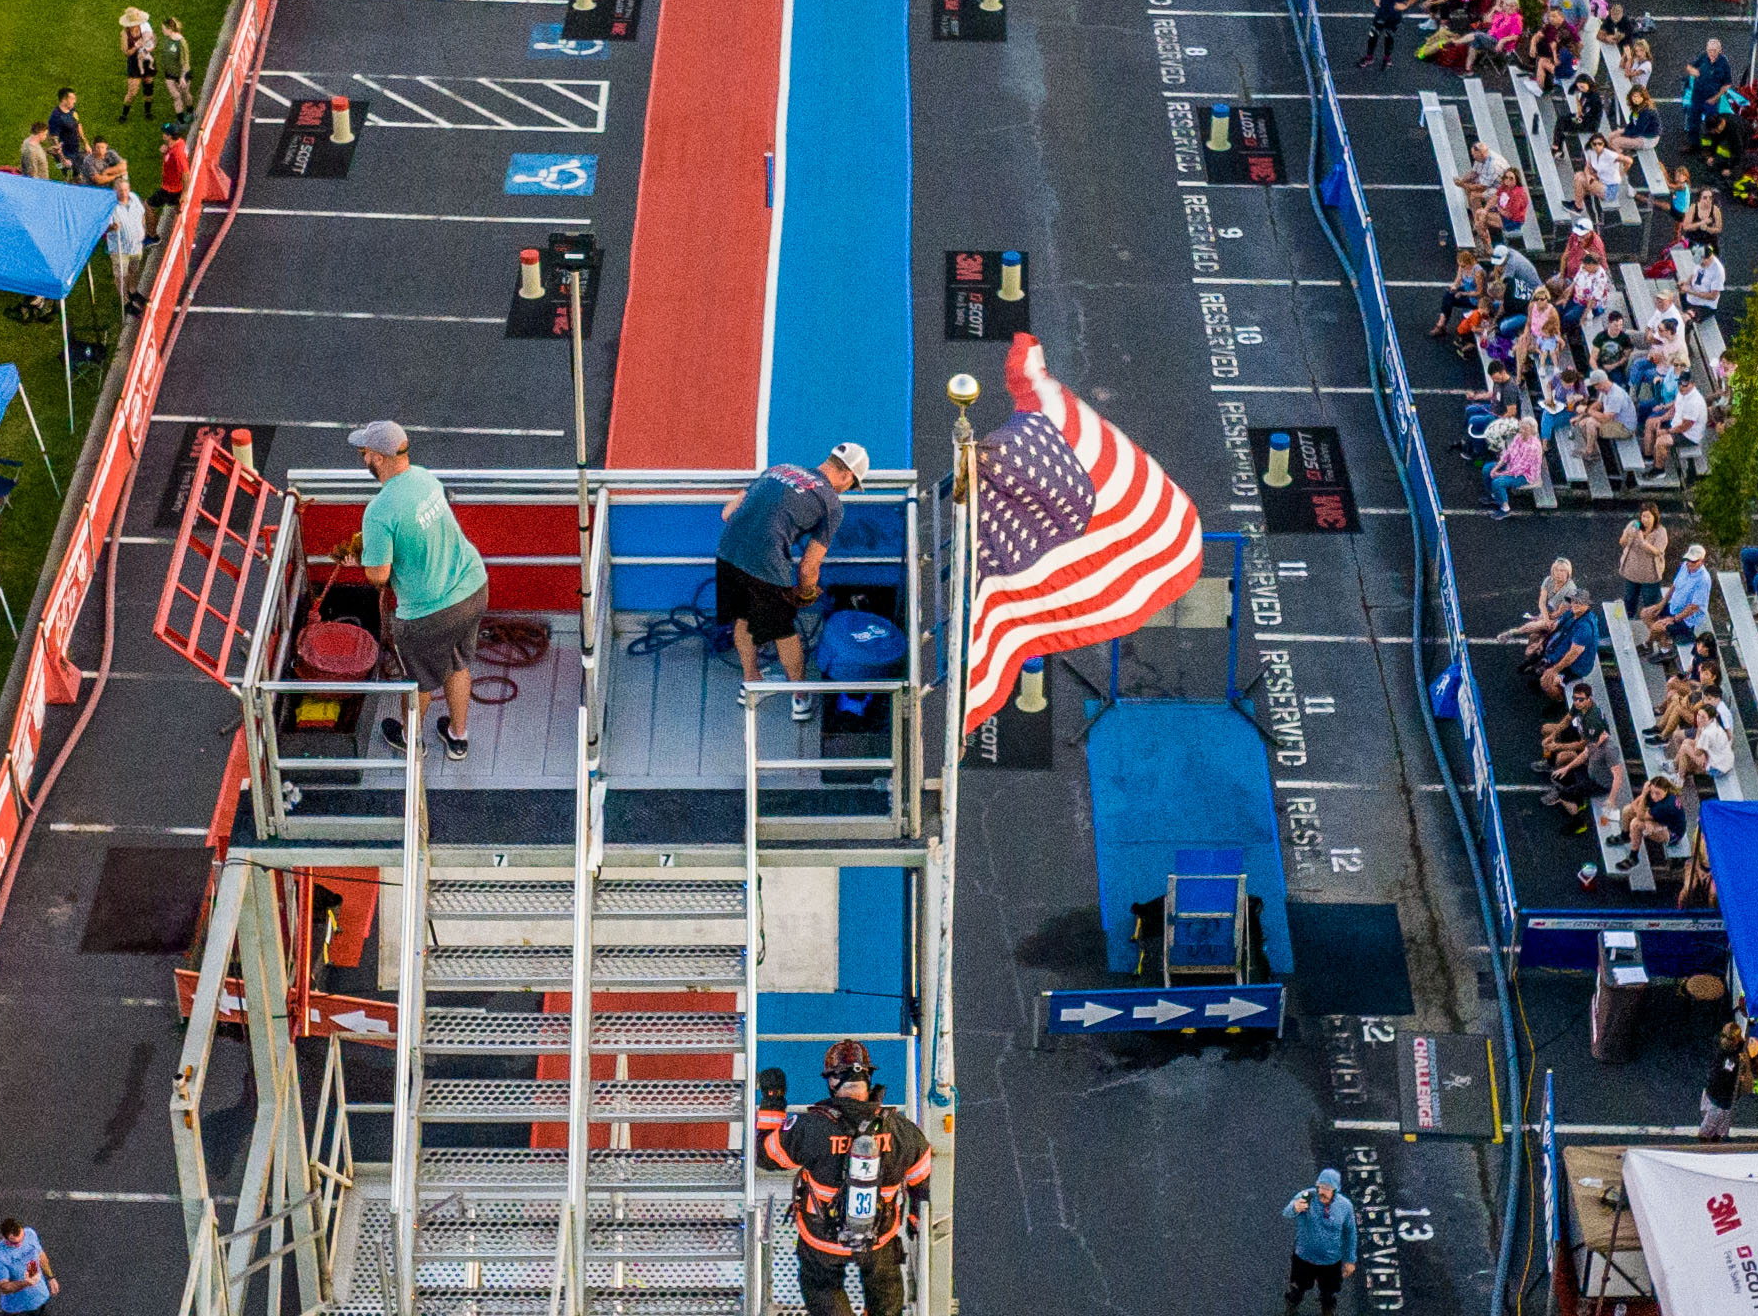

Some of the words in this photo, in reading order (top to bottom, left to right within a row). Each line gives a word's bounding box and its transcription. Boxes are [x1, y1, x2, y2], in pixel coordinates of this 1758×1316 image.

[1153, 17, 1186, 85] RESERVED
[1184, 46, 1209, 58] 8
[1166, 100, 1201, 173] RESERVED
[1248, 155, 1277, 183] 3M
[1181, 193, 1220, 276] RESERVED
[1218, 227, 1244, 239] 9
[956, 253, 985, 282] 3M
[969, 303, 986, 338] SCOTT
[1198, 291, 1239, 379] RESERVED
[1234, 324, 1264, 346] 10
[1298, 431, 1316, 468] SCOTT
[1312, 494, 1347, 530] 3M
[1277, 561, 1309, 578] 11
[1258, 649, 1308, 768] RESERVED
[1303, 696, 1336, 716] 11
[494, 853, 507, 867] 7
[660, 853, 673, 867] 7
[1330, 848, 1364, 874] 12
[855, 1191, 872, 1215] 33
[1706, 1192, 1742, 1236] 3M
[1342, 1144, 1403, 1313] RESERVED
[1393, 1207, 1435, 1243] 13
